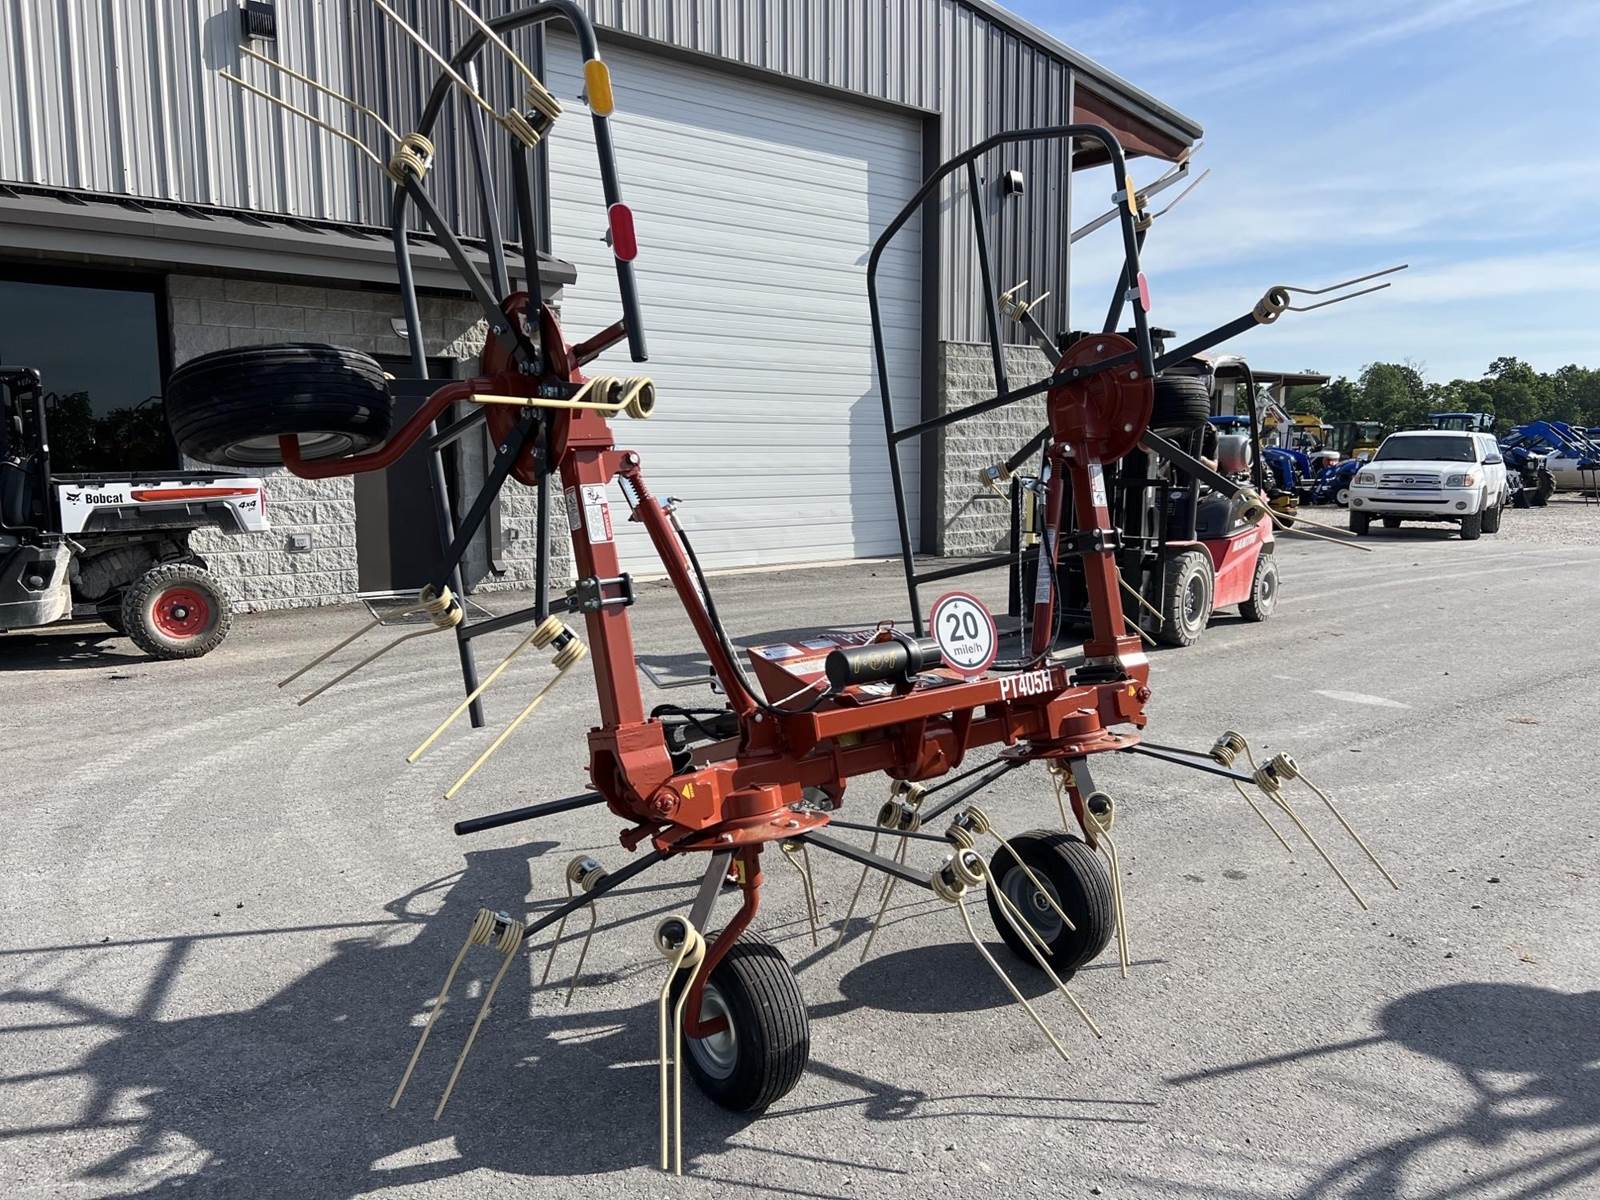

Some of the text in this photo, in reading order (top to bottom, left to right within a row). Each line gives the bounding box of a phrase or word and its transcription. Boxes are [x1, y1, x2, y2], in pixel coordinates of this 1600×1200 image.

[85, 493, 123, 504] Bobcat
[238, 500, 257, 508] 4x4
[945, 611, 979, 642] 20
[953, 643, 983, 656] mile/h
[999, 669, 1053, 701] PT405H
